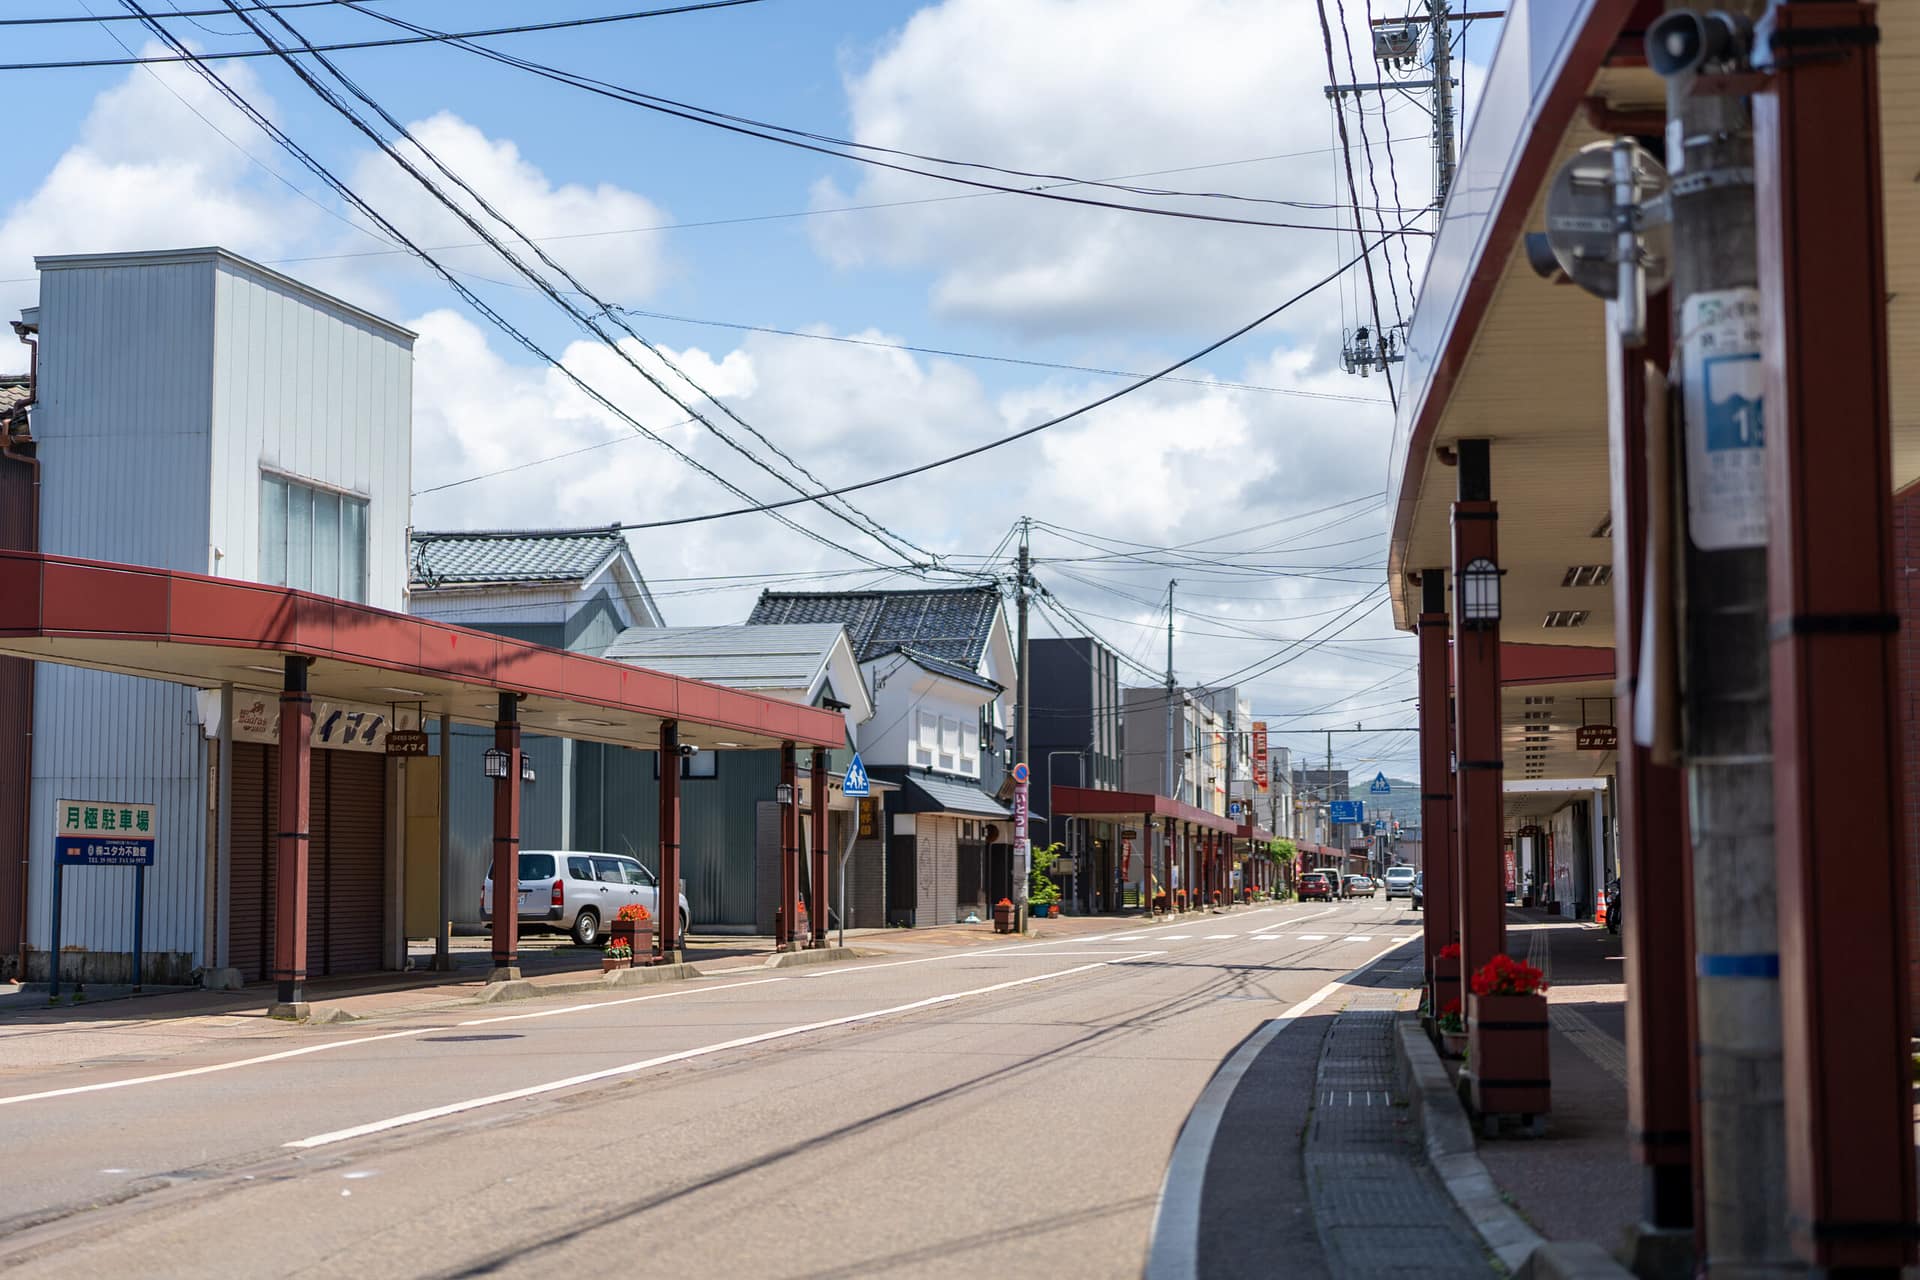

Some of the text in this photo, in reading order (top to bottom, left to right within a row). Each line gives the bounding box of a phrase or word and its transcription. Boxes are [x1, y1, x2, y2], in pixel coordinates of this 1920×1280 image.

[66, 806, 150, 832] 月極駐車場
